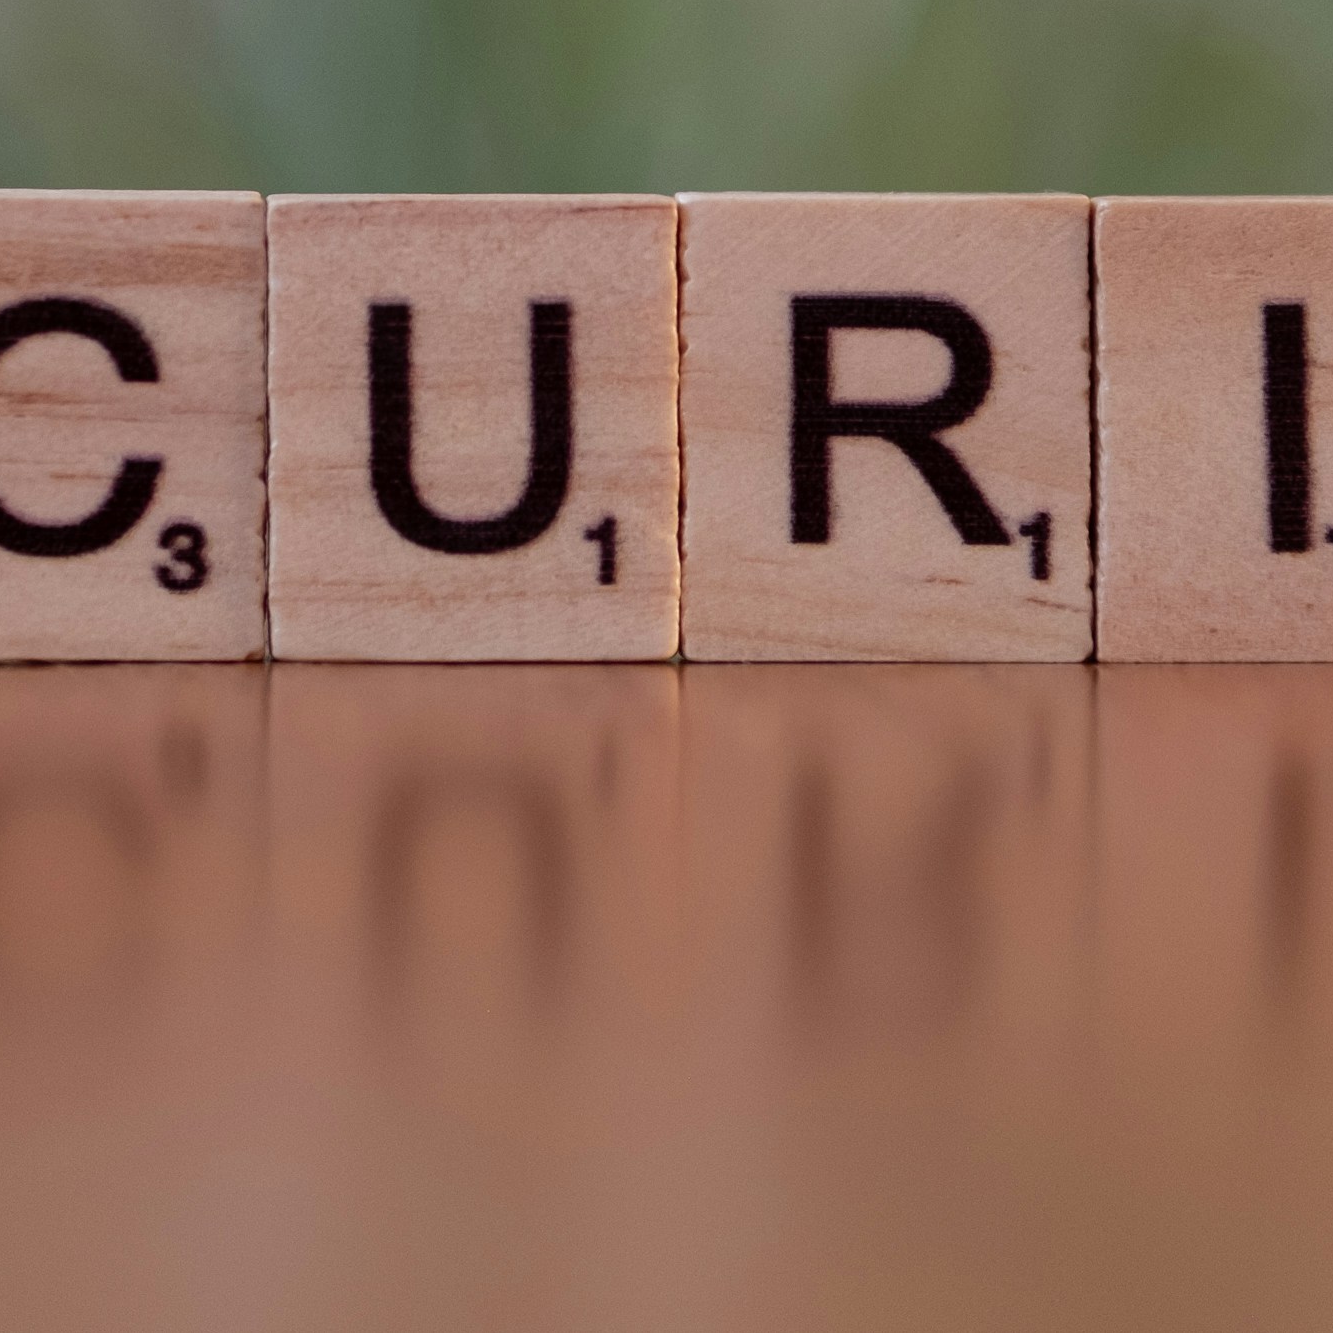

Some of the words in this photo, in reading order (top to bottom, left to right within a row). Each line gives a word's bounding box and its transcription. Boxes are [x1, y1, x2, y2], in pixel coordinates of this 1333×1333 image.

[152, 520, 213, 596] 3
[582, 514, 621, 587] 1
[1017, 510, 1054, 583] 1
